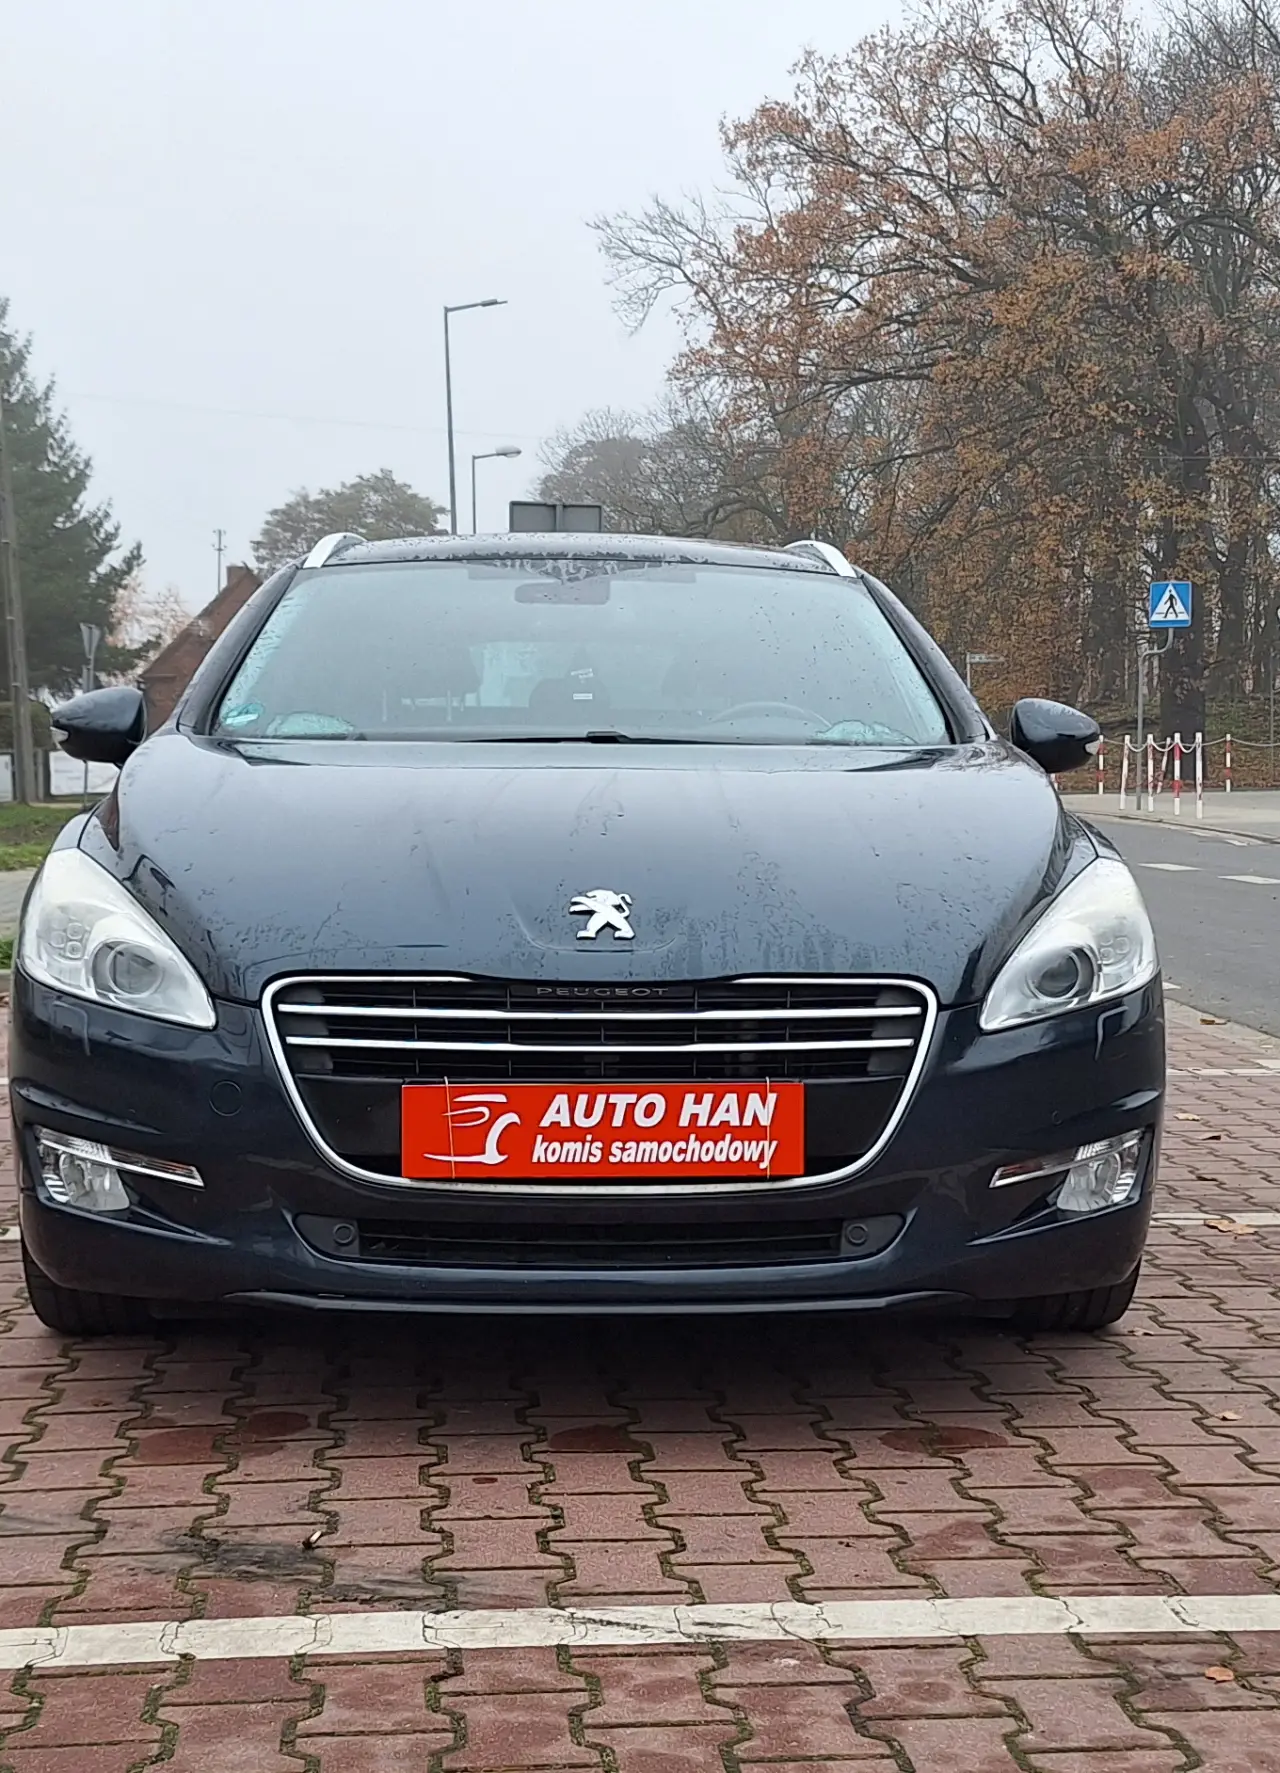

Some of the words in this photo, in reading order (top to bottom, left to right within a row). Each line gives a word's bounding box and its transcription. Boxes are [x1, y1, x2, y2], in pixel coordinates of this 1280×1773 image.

[536, 986, 669, 997] PEUGEOT
[539, 1092, 666, 1128] AUTO
[678, 1092, 778, 1128] HAN
[531, 1134, 603, 1164] komis
[608, 1134, 778, 1169] samochodowy
